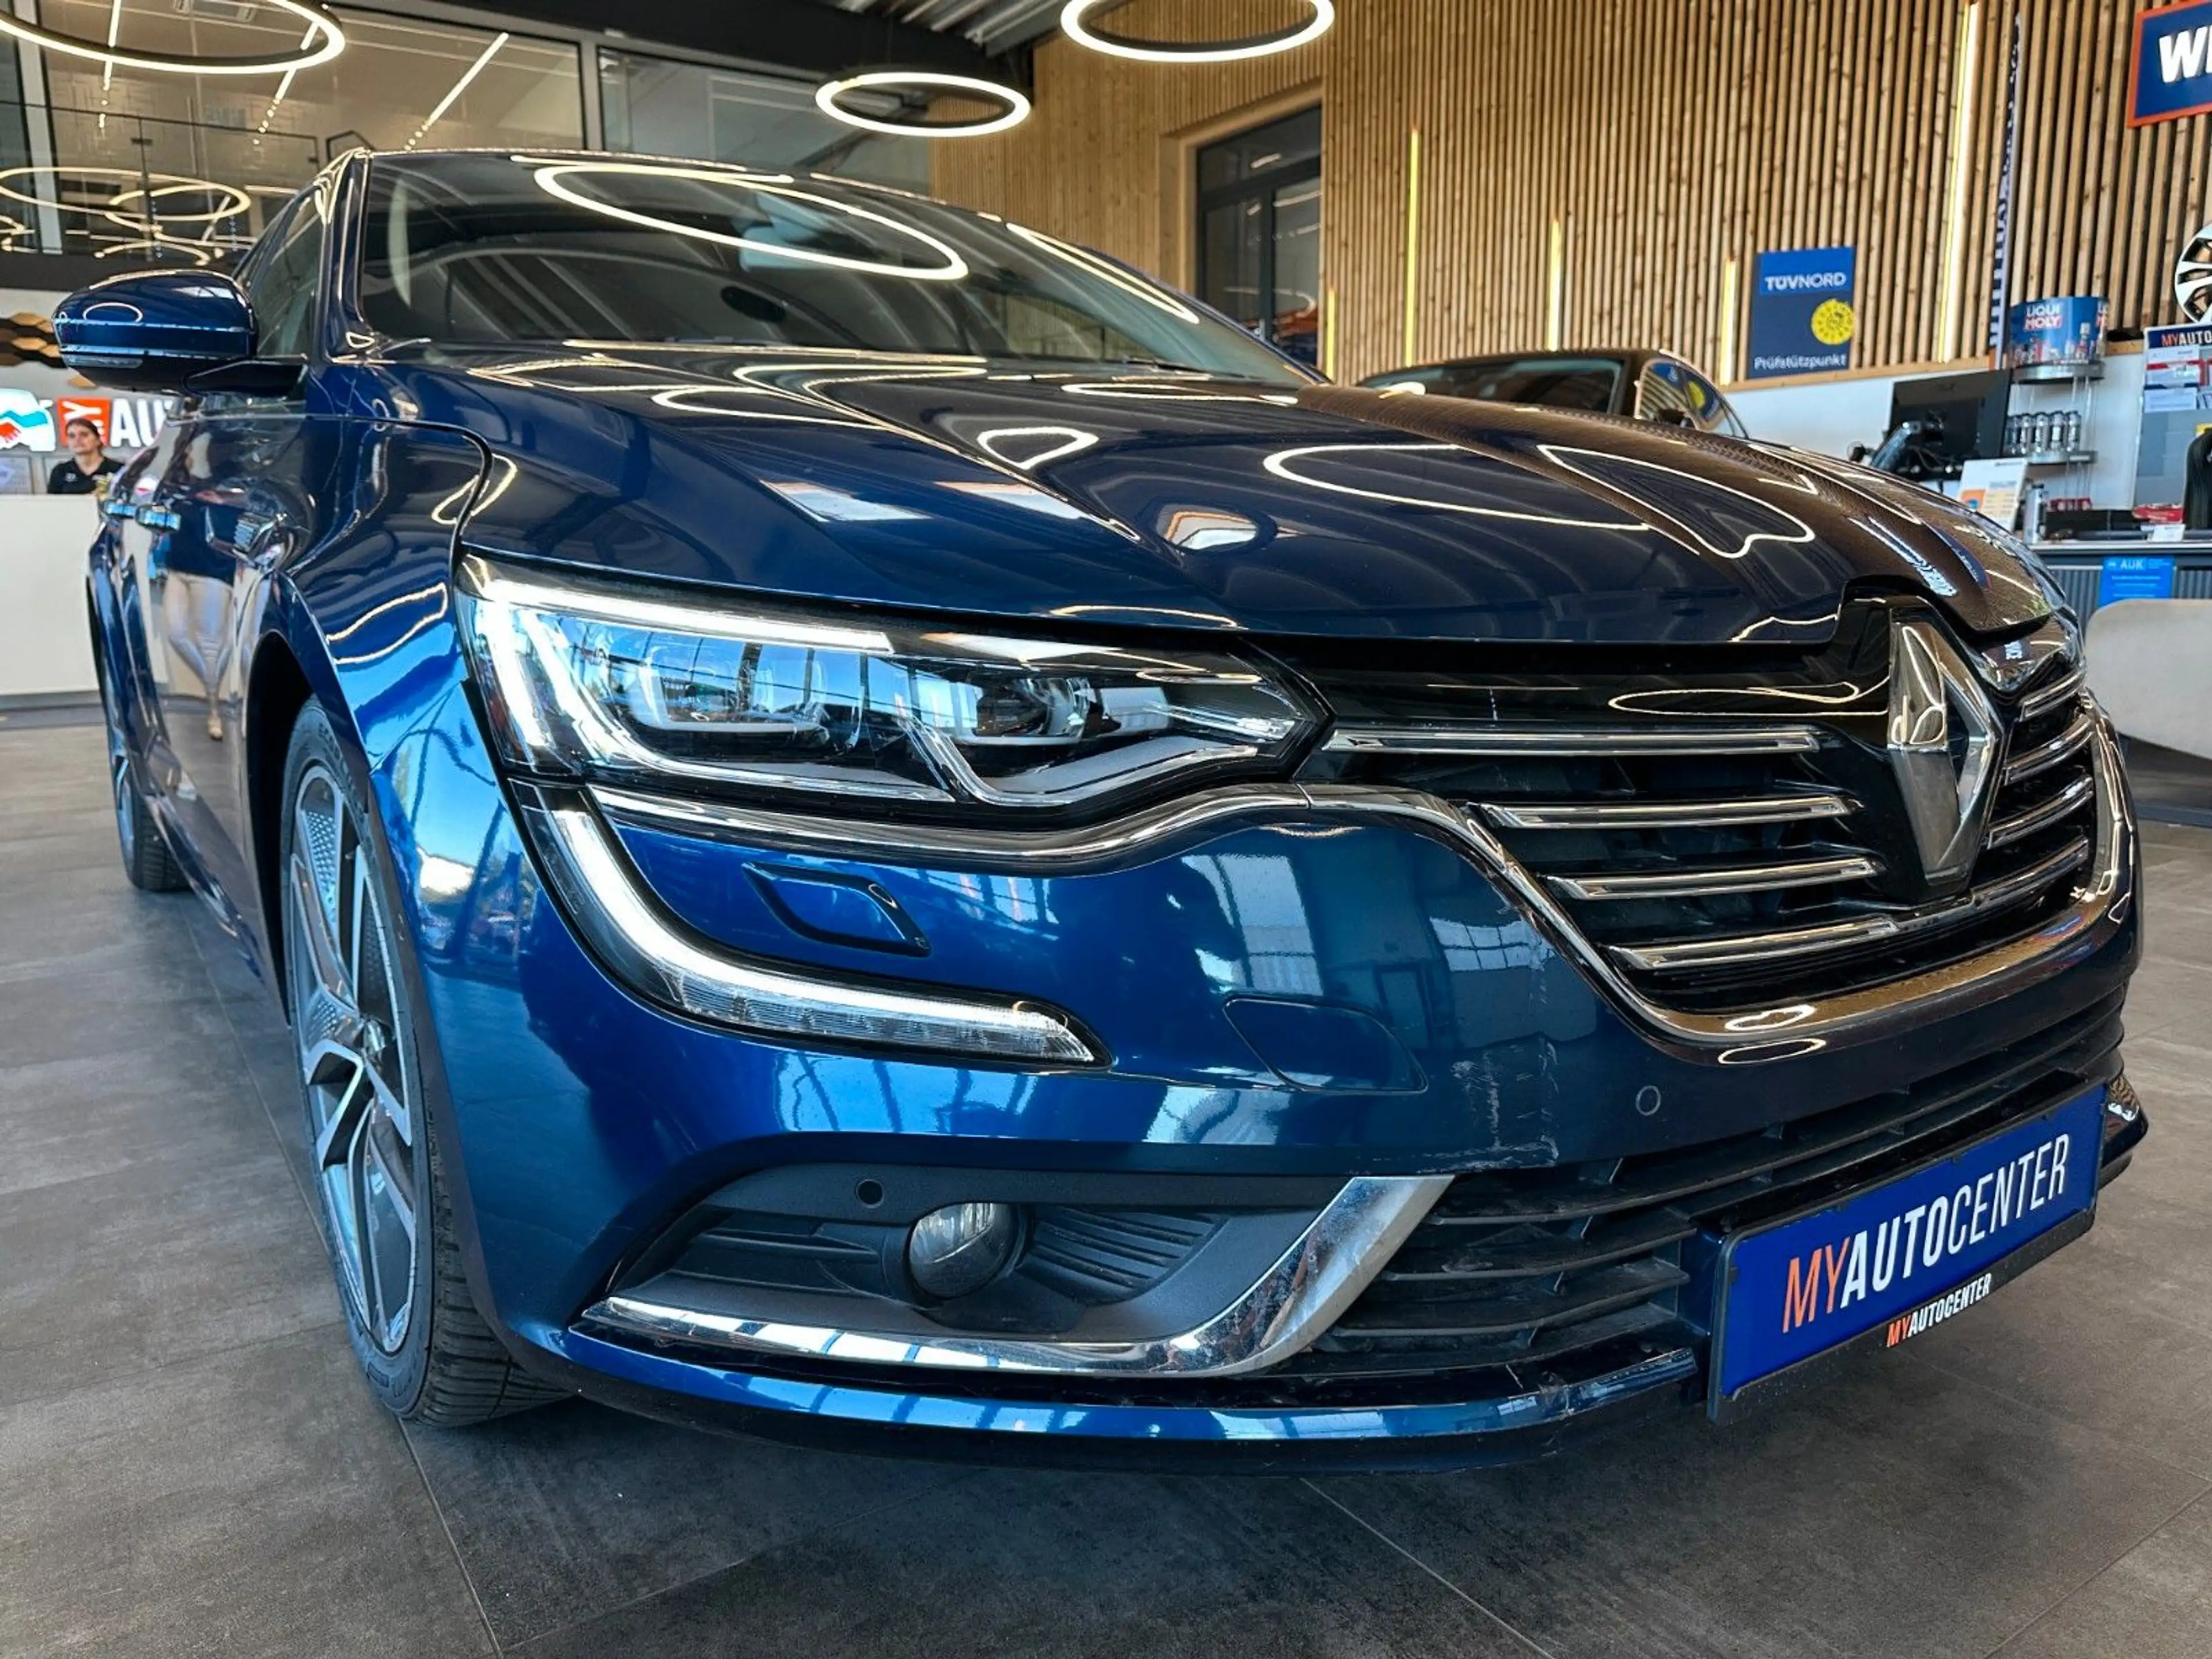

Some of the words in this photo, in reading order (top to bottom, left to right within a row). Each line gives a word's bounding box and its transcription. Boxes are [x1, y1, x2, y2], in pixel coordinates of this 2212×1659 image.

[2026, 303, 2062, 316] LIQUI
[2025, 315, 2063, 331] MOLY
[1754, 354, 1847, 370] Prüfstützpunkt
[1783, 1133, 2070, 1334] MYAUTOCENTER
[1887, 1273, 1992, 1347] MYAUTOCENTER
